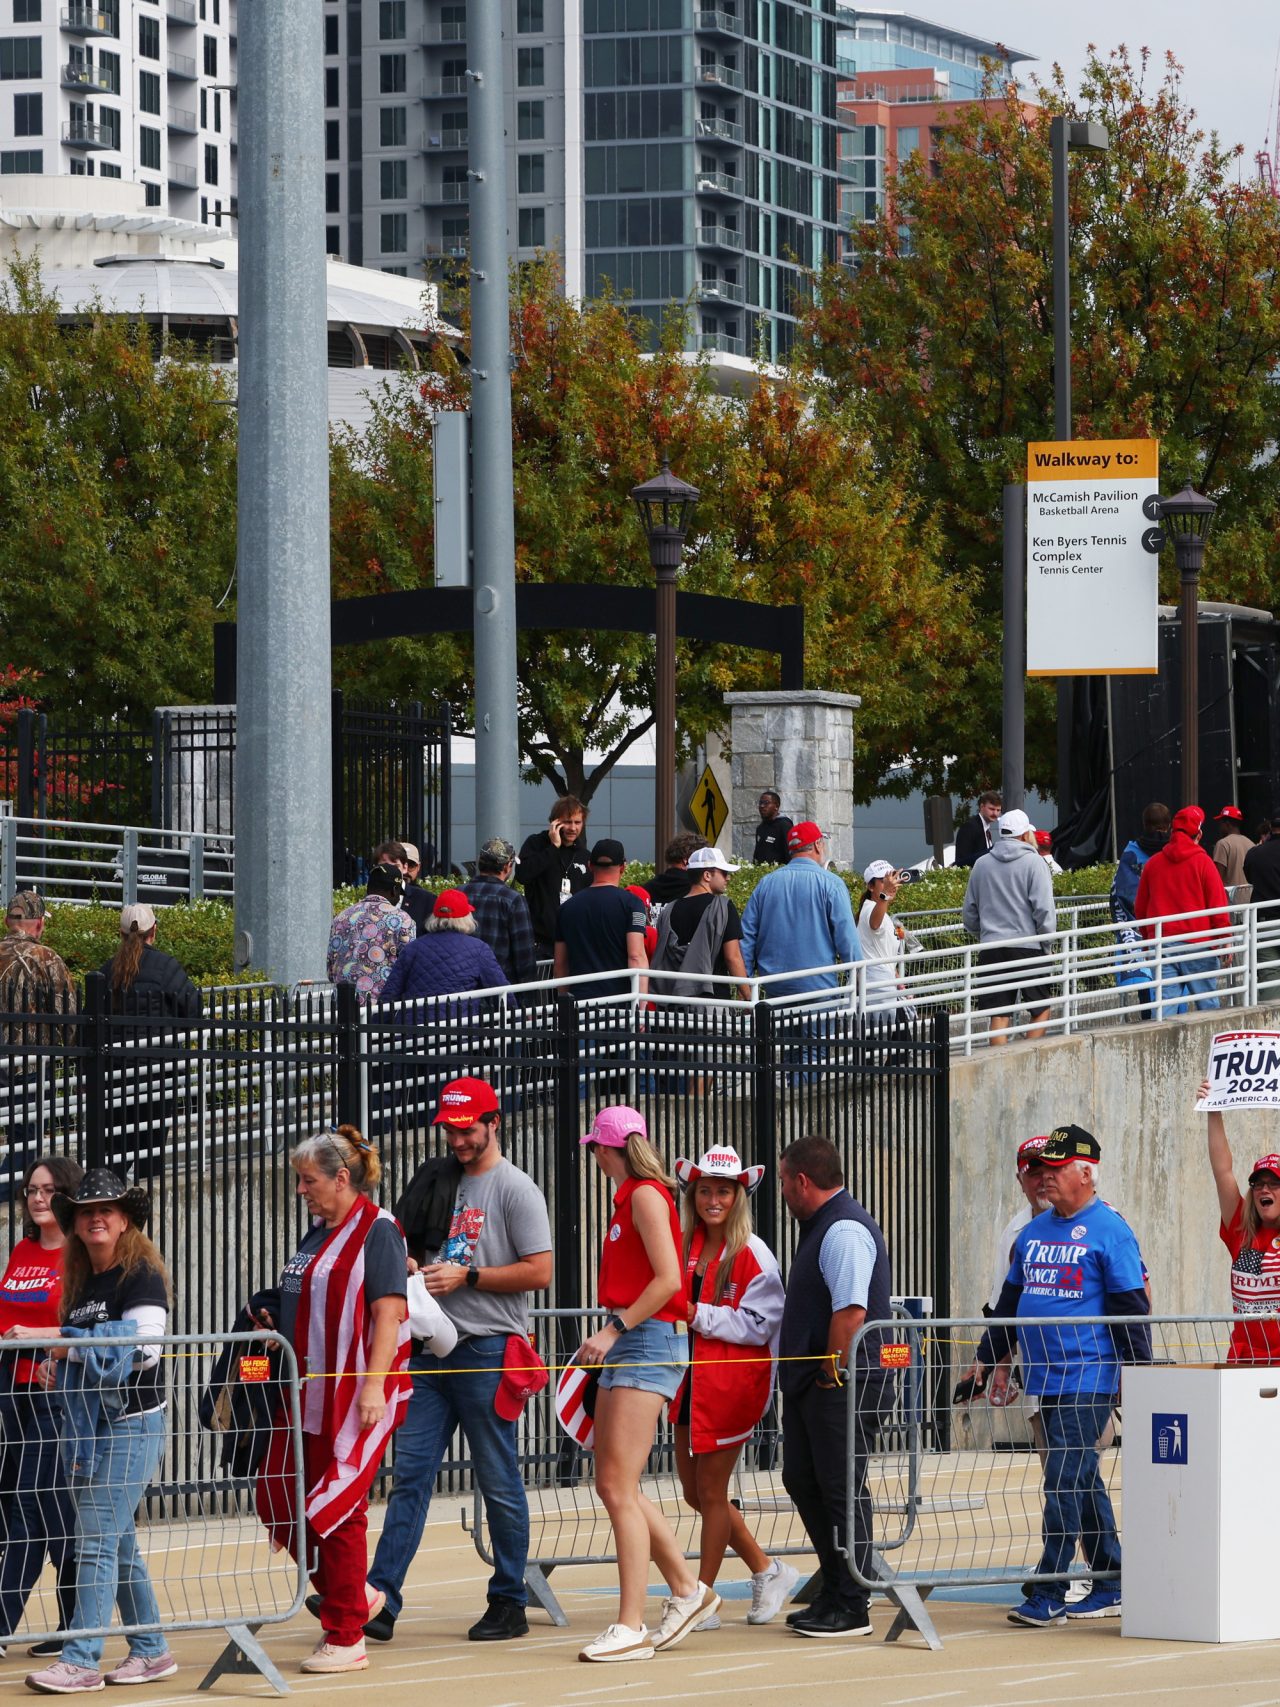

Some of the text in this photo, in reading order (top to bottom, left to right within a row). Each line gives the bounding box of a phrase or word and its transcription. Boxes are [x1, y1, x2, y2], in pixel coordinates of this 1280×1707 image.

[1035, 452, 1138, 469] Walkway to:
[1033, 490, 1138, 503] McCamish Pavilion
[1039, 506, 1119, 516] Basketball Arena
[1033, 535, 1127, 548] Ken Byers Tennis
[1033, 551, 1082, 563] Complex
[1039, 565, 1103, 575] Tennis Center
[1227, 1078, 1278, 1094] 2024
[442, 1094, 472, 1103] TRUMP
[1207, 1099, 1228, 1107] TAKE
[1024, 1138, 1048, 1150] JESU
[706, 1154, 738, 1163] TRUMP
[710, 1160, 731, 1168] 2024
[1024, 1240, 1087, 1264] TRUMP
[13, 1266, 50, 1278] FAITH
[1023, 1263, 1058, 1284] VANCE
[4, 1278, 48, 1291] FAMILY
[283, 1277, 303, 1293] 202
[1028, 1286, 1056, 1297] AMERICA
[1058, 1289, 1084, 1299] BACK!
[69, 1301, 107, 1319] GEORGIA
[241, 1359, 252, 1367] USA
